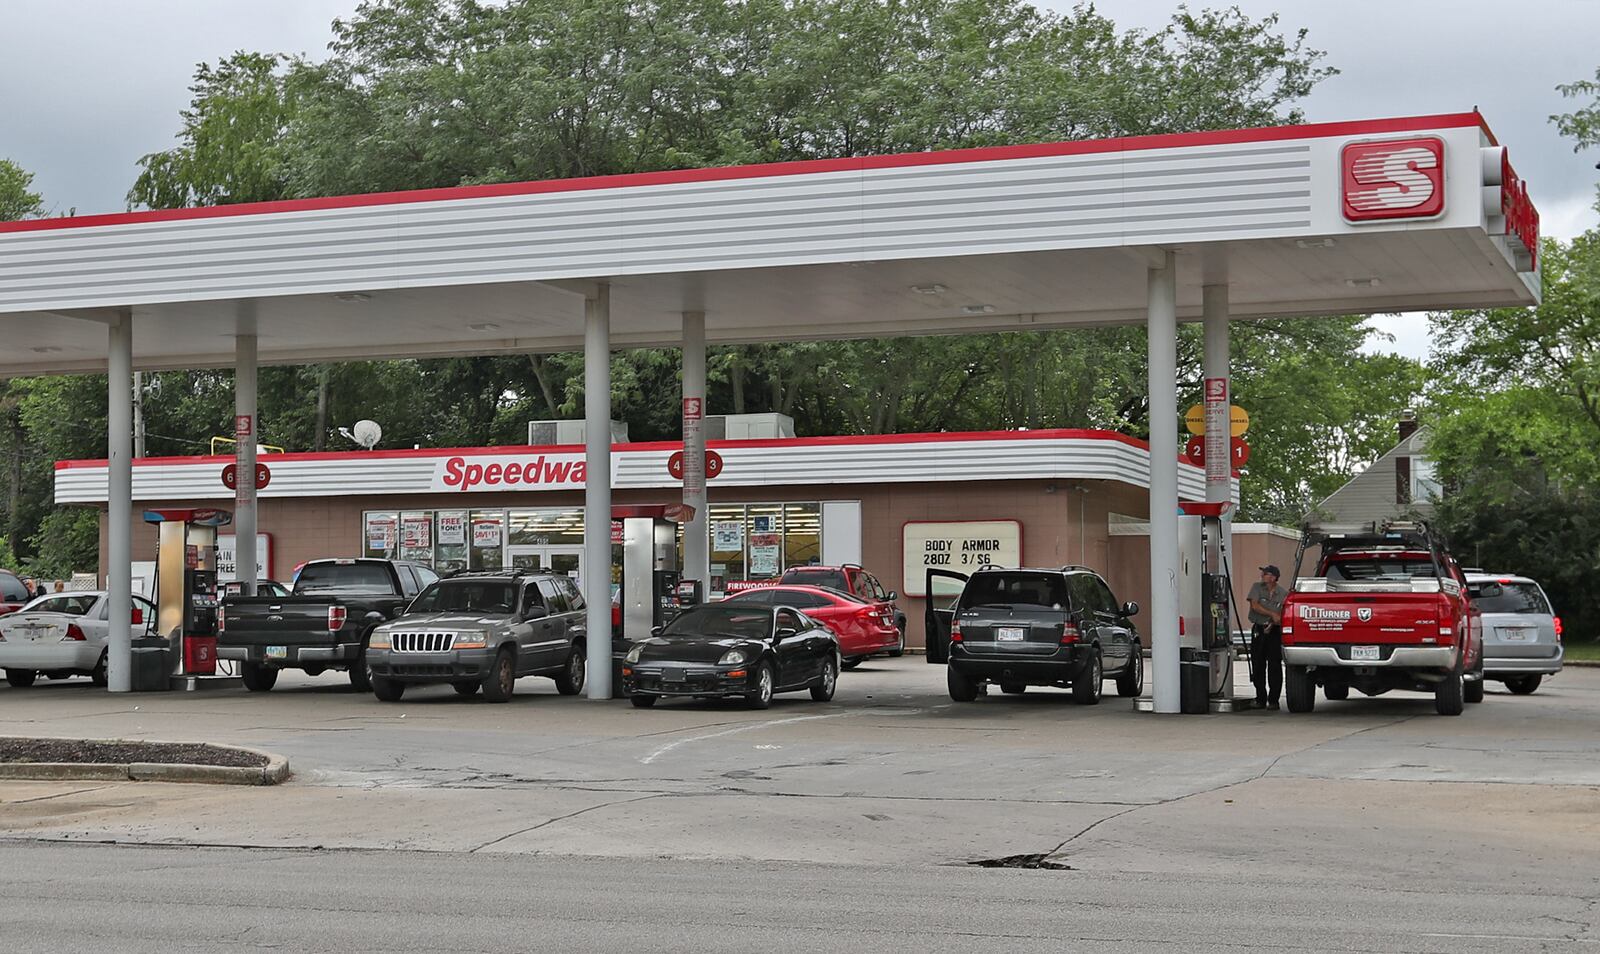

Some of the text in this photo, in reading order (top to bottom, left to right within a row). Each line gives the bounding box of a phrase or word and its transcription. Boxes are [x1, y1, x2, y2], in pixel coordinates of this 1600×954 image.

[1347, 147, 1437, 211] S
[1193, 445, 1201, 457] 2
[1235, 446, 1242, 458] 1
[673, 461, 681, 471] 4
[709, 459, 717, 470] 3
[226, 472, 234, 482] 6
[259, 470, 266, 481] 5
[443, 456, 586, 490] Speedwa
[926, 540, 1000, 551] BODY ARMOR
[217, 551, 232, 560] AIN
[217, 563, 234, 573] FREE
[1316, 608, 1350, 619] TURNER
